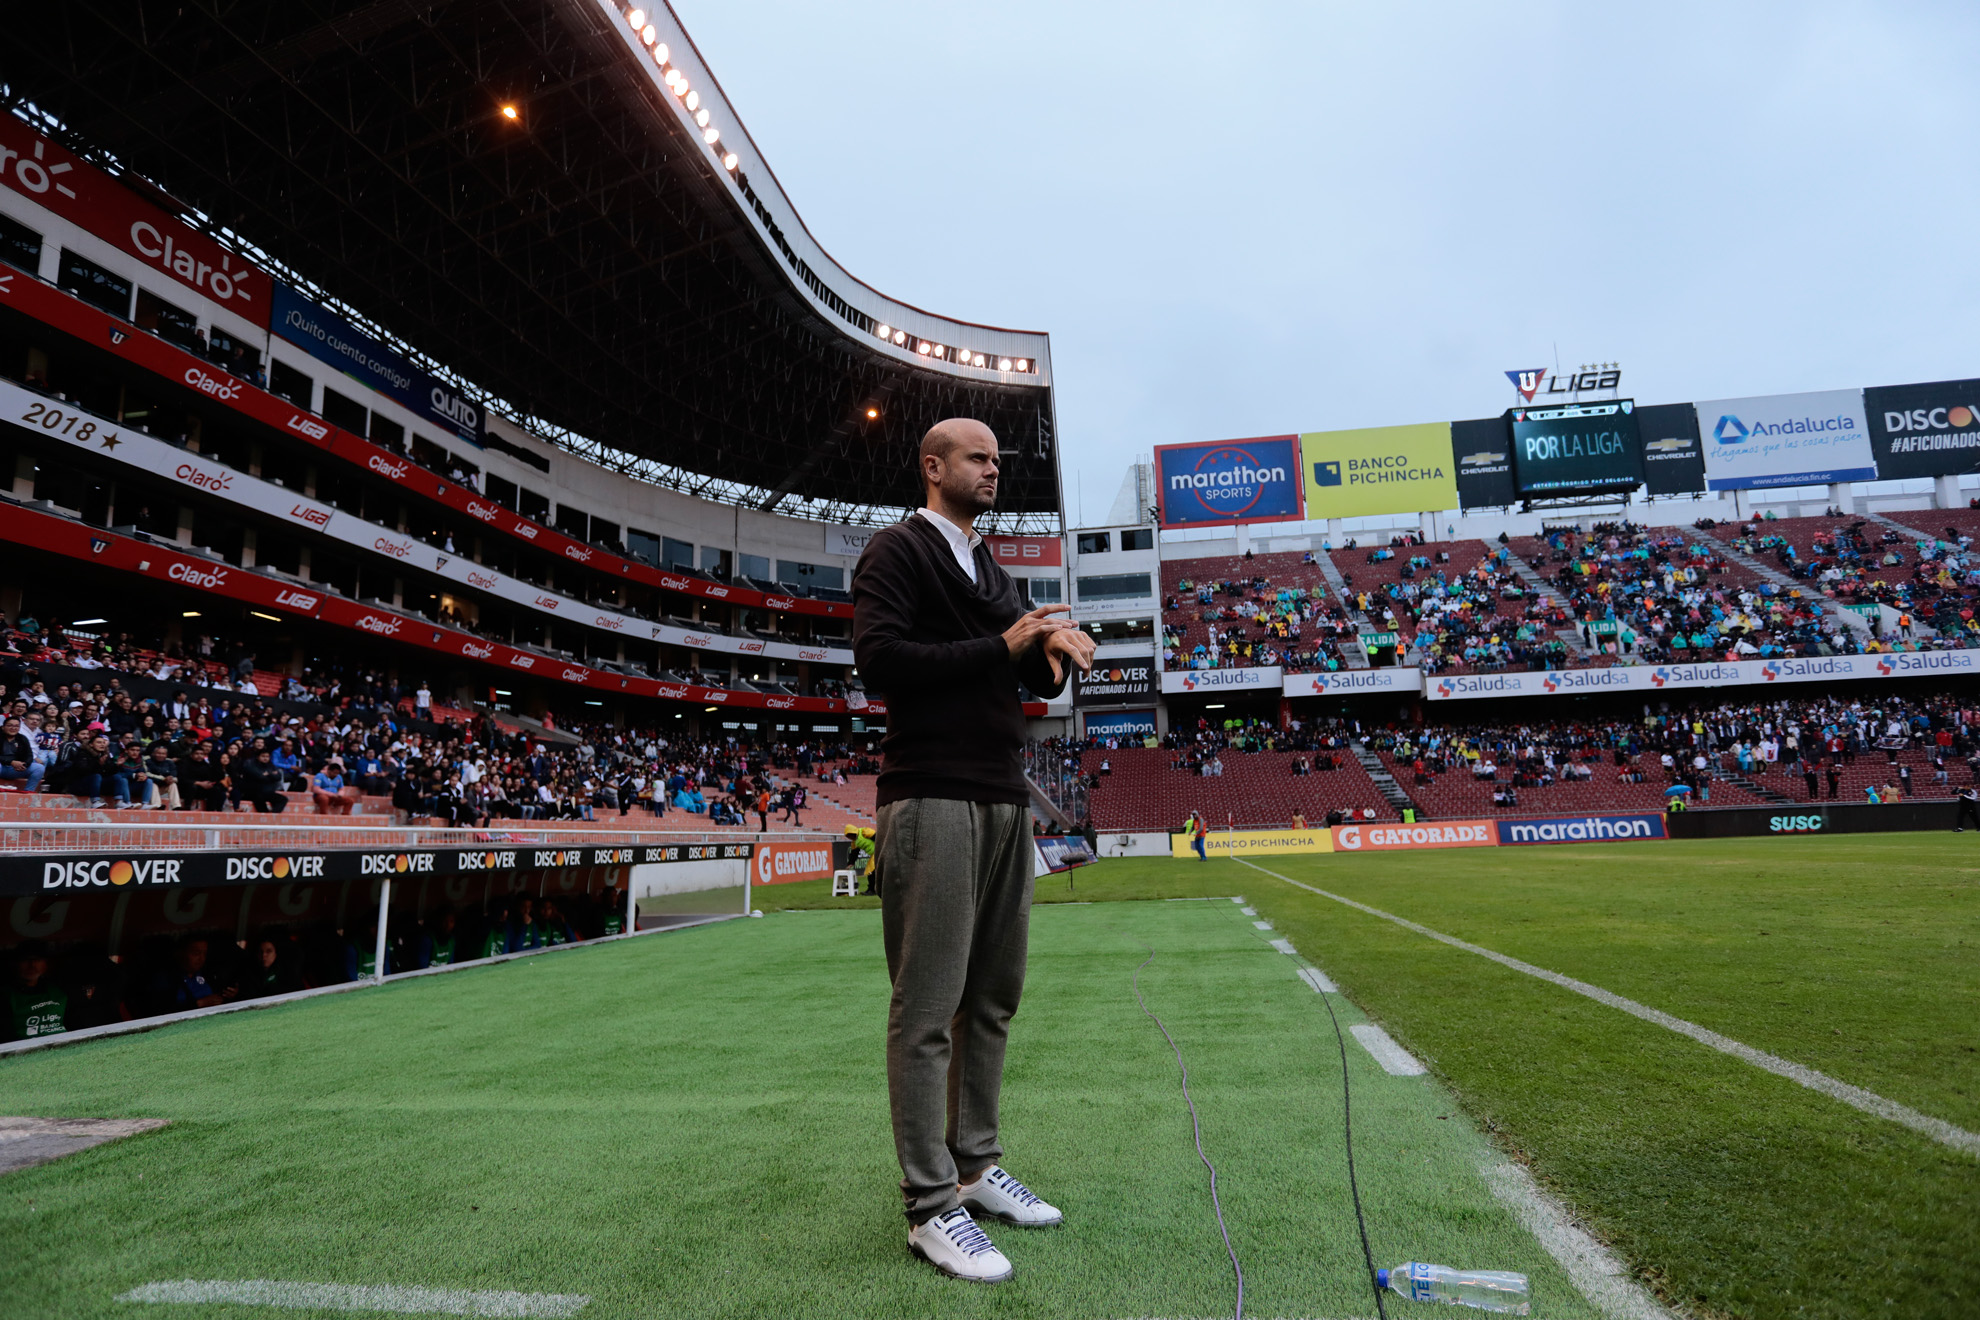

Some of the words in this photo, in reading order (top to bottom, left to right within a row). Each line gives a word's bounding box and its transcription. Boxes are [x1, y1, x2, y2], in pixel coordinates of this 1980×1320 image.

[130, 221, 235, 299] Claro
[328, 334, 367, 365] cuenta
[367, 358, 411, 391] contigo!
[185, 368, 233, 400] Claro
[21, 402, 97, 442] 2018
[1751, 415, 1855, 437] Andalucía
[1526, 436, 1559, 460] POR
[1562, 434, 1584, 458] LA
[1586, 431, 1624, 455] LIGA
[1763, 441, 1780, 456] que
[1785, 437, 1800, 449] las
[1803, 436, 1829, 447] cosas
[1349, 456, 1407, 471] BANCO
[1647, 452, 1697, 461] CHEVROLET
[369, 455, 402, 480] Claro
[1350, 467, 1444, 484] PICHINCHA
[1461, 464, 1510, 475] CHEVROLET
[176, 464, 223, 492] Claro
[1171, 464, 1285, 490] marathon
[1206, 486, 1252, 500] SPORTS
[467, 501, 492, 521] Claro
[374, 538, 406, 558] Claro
[565, 545, 588, 562] Claro
[169, 563, 219, 588] Claro
[467, 571, 492, 589] Claro
[661, 577, 685, 590] Claro
[766, 598, 790, 610] Claro
[361, 616, 397, 635] Claro
[596, 616, 619, 630] Claro
[684, 635, 708, 647] Claro
[462, 643, 490, 659] Claro
[799, 650, 823, 661] Claro
[1783, 658, 1853, 676] Saludsa
[1898, 652, 1972, 670] Saludsa
[562, 669, 585, 682] Claro
[1201, 669, 1260, 686] Saludsa
[1331, 672, 1392, 689] Saludsa
[1564, 670, 1629, 687] Saludsa
[1671, 664, 1739, 682] Saludsa
[659, 686, 683, 698] Claro
[1079, 685, 1126, 696] #AFICIONADOS
[1127, 684, 1132, 694] A
[1133, 684, 1142, 693] LA
[1143, 684, 1149, 693] U
[1458, 675, 1521, 692] Saludsa
[767, 697, 790, 709] Claro
[1087, 720, 1154, 736] marathon
[1369, 825, 1488, 845] GATORADE
[1511, 818, 1651, 841] marathon
[724, 846, 749, 857] DISCOVER
[1207, 839, 1246, 850] BANCO
[1250, 837, 1315, 849] PICHINCHA
[459, 852, 515, 870] DISCOVER
[535, 851, 581, 867] DISCOVER
[595, 849, 634, 864] DISCOVER
[646, 848, 678, 862] DISCOVER
[689, 847, 717, 859] DISCOVER
[226, 856, 324, 880] DISCOVER
[361, 853, 434, 875] DISCOVER
[775, 850, 828, 876] GATORADE
[43, 859, 181, 888] DISCOVER
